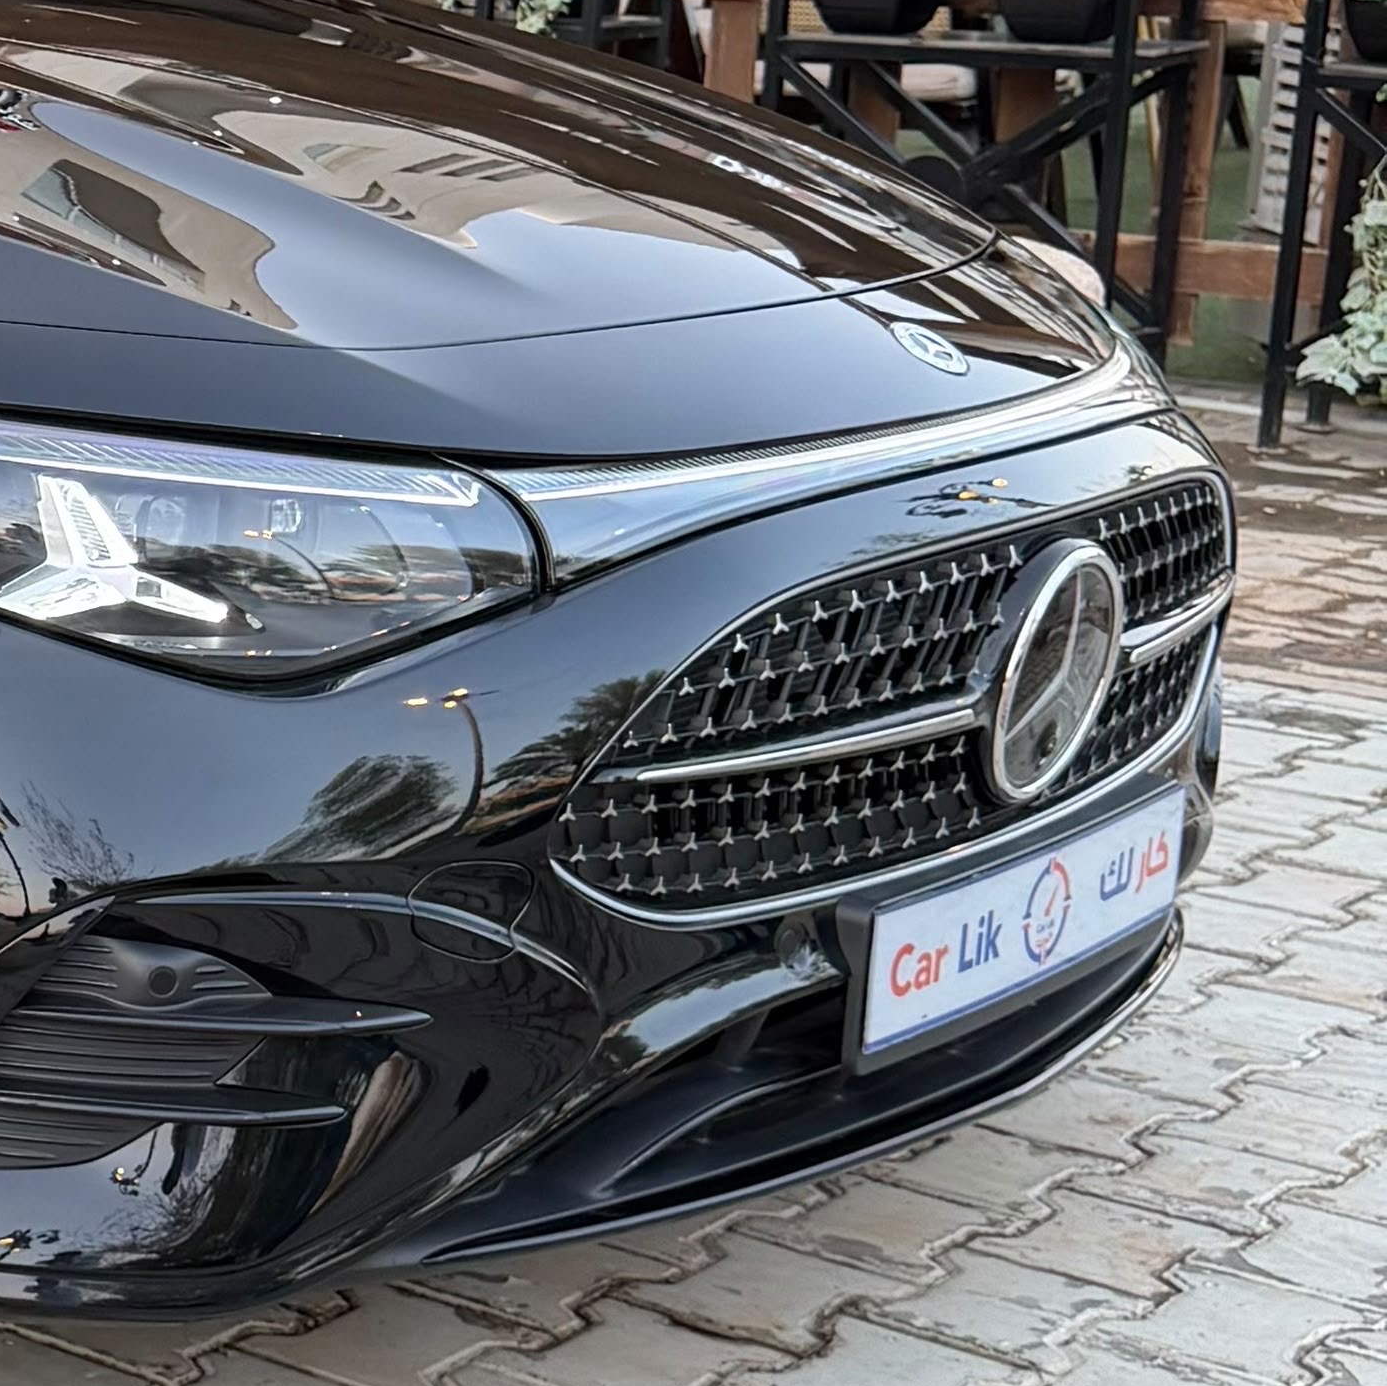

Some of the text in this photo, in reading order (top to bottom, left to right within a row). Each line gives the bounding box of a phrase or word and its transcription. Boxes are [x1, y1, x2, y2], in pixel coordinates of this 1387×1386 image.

[1099, 831, 1169, 903] كار لك
[890, 943, 948, 997] Car
[958, 910, 1003, 973] Lik
